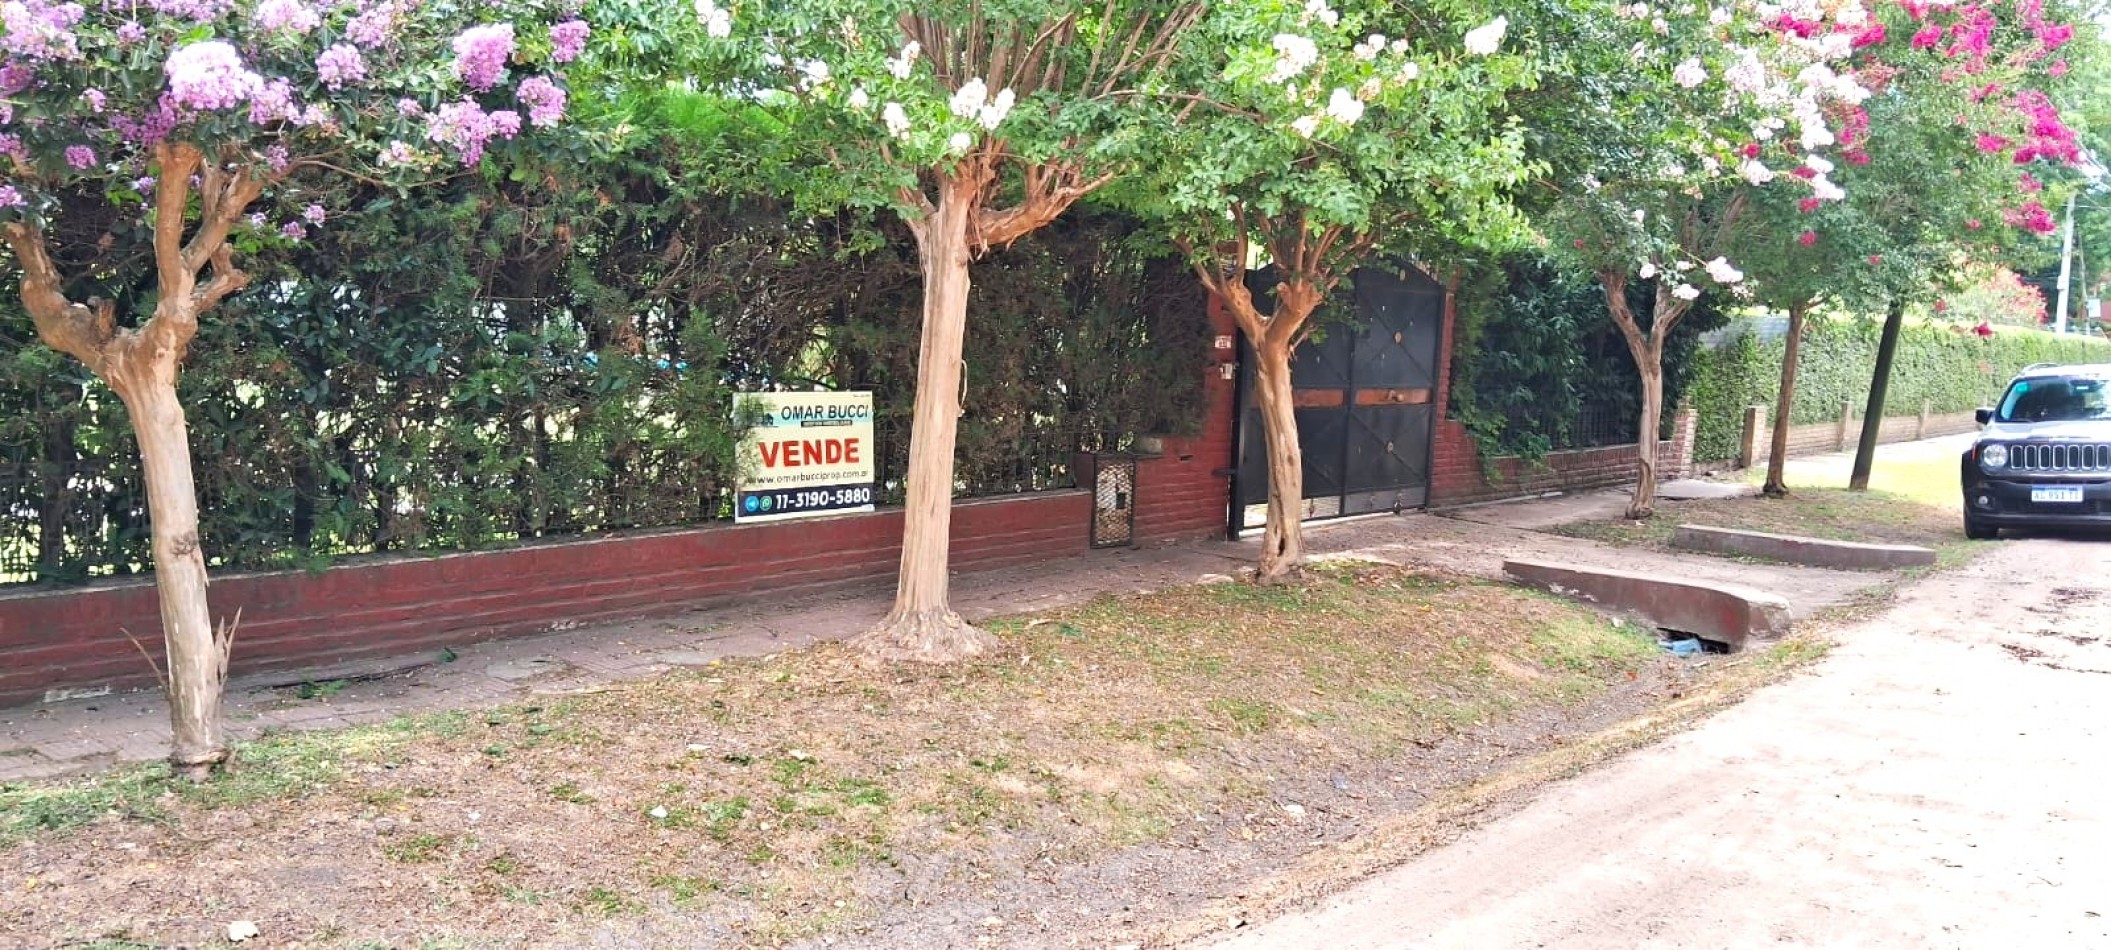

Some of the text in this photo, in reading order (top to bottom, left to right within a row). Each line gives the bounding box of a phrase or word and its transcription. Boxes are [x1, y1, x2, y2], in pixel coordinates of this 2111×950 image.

[781, 404, 869, 420] OMAR BUCCI
[758, 437, 860, 468] VENDE
[775, 487, 870, 509] 11-3190-5880
